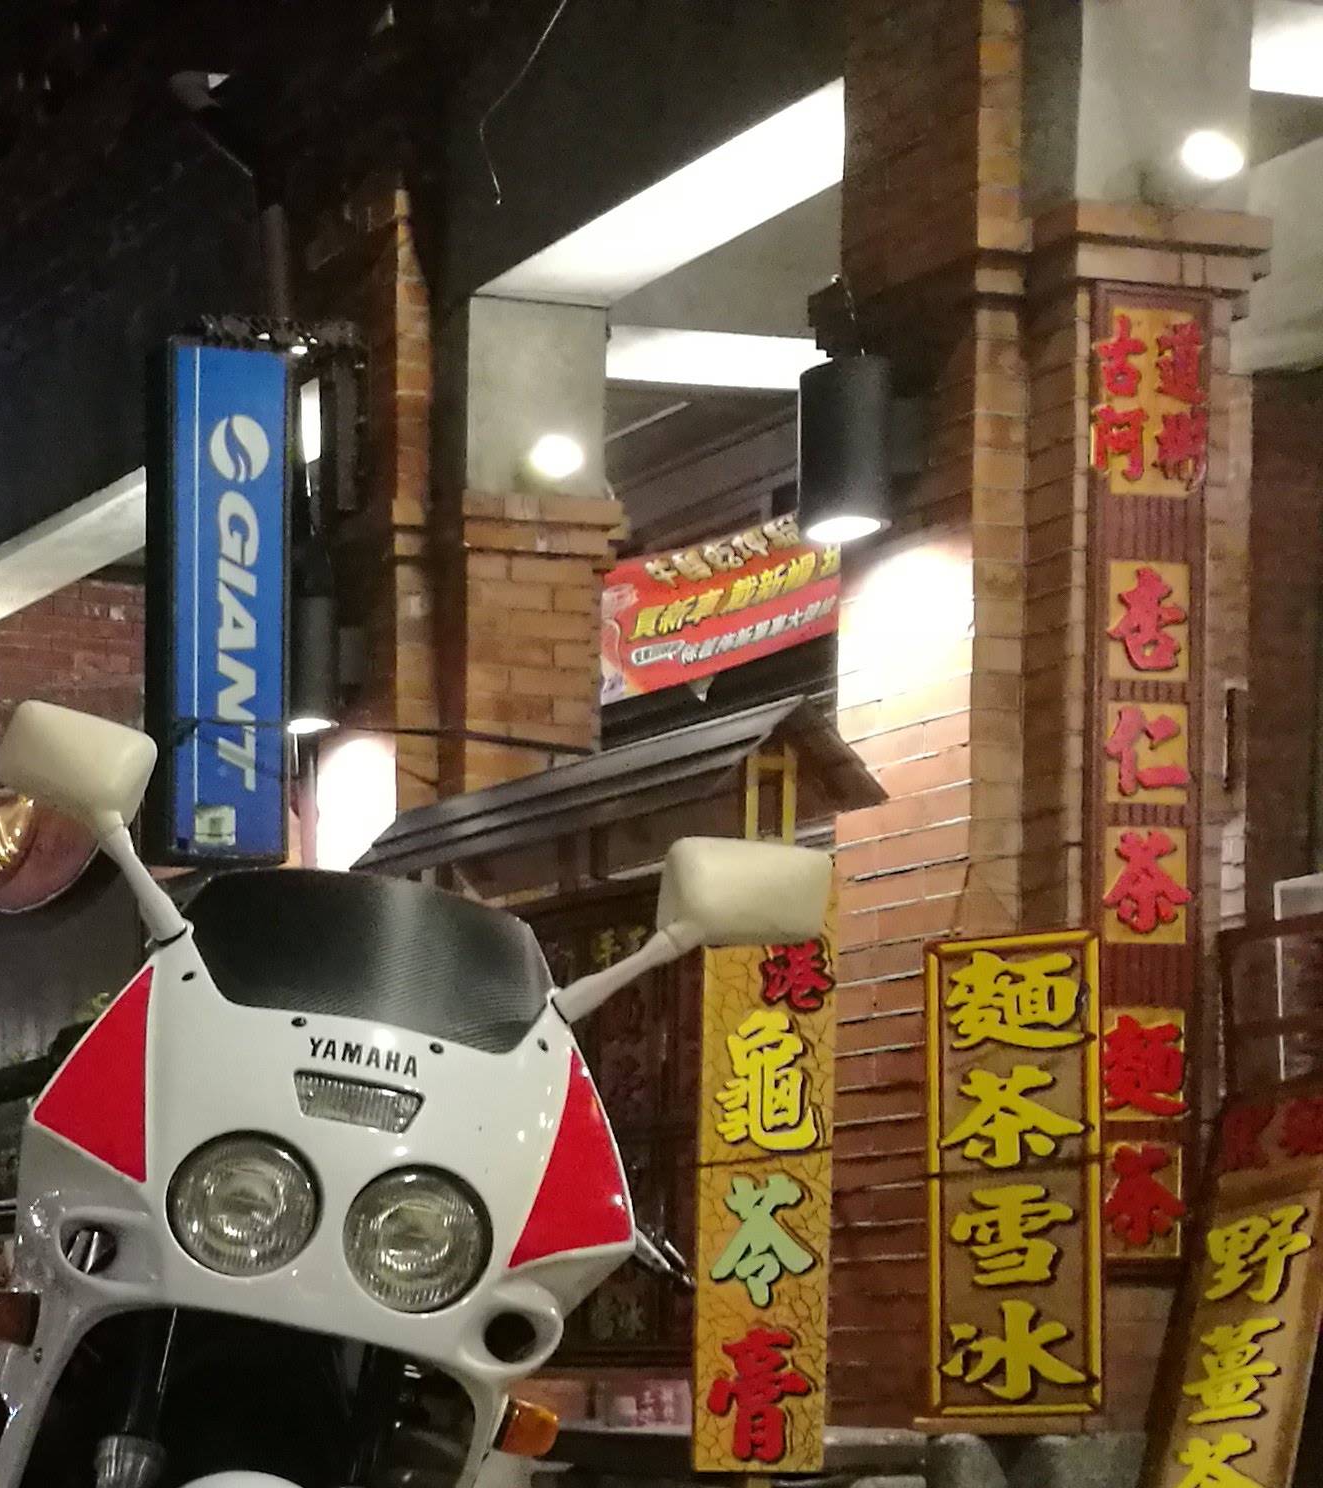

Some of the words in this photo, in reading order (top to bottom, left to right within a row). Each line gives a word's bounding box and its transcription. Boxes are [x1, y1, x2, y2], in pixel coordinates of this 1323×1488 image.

[217, 490, 260, 792] GIANT
[1103, 567, 1192, 934] 杏仁茶
[309, 1036, 417, 1078] YAMAHA
[939, 950, 1088, 1400] 麵茶雪冰
[1104, 1014, 1187, 1245] 麵茶
[707, 1008, 819, 1464] 龜苓膏
